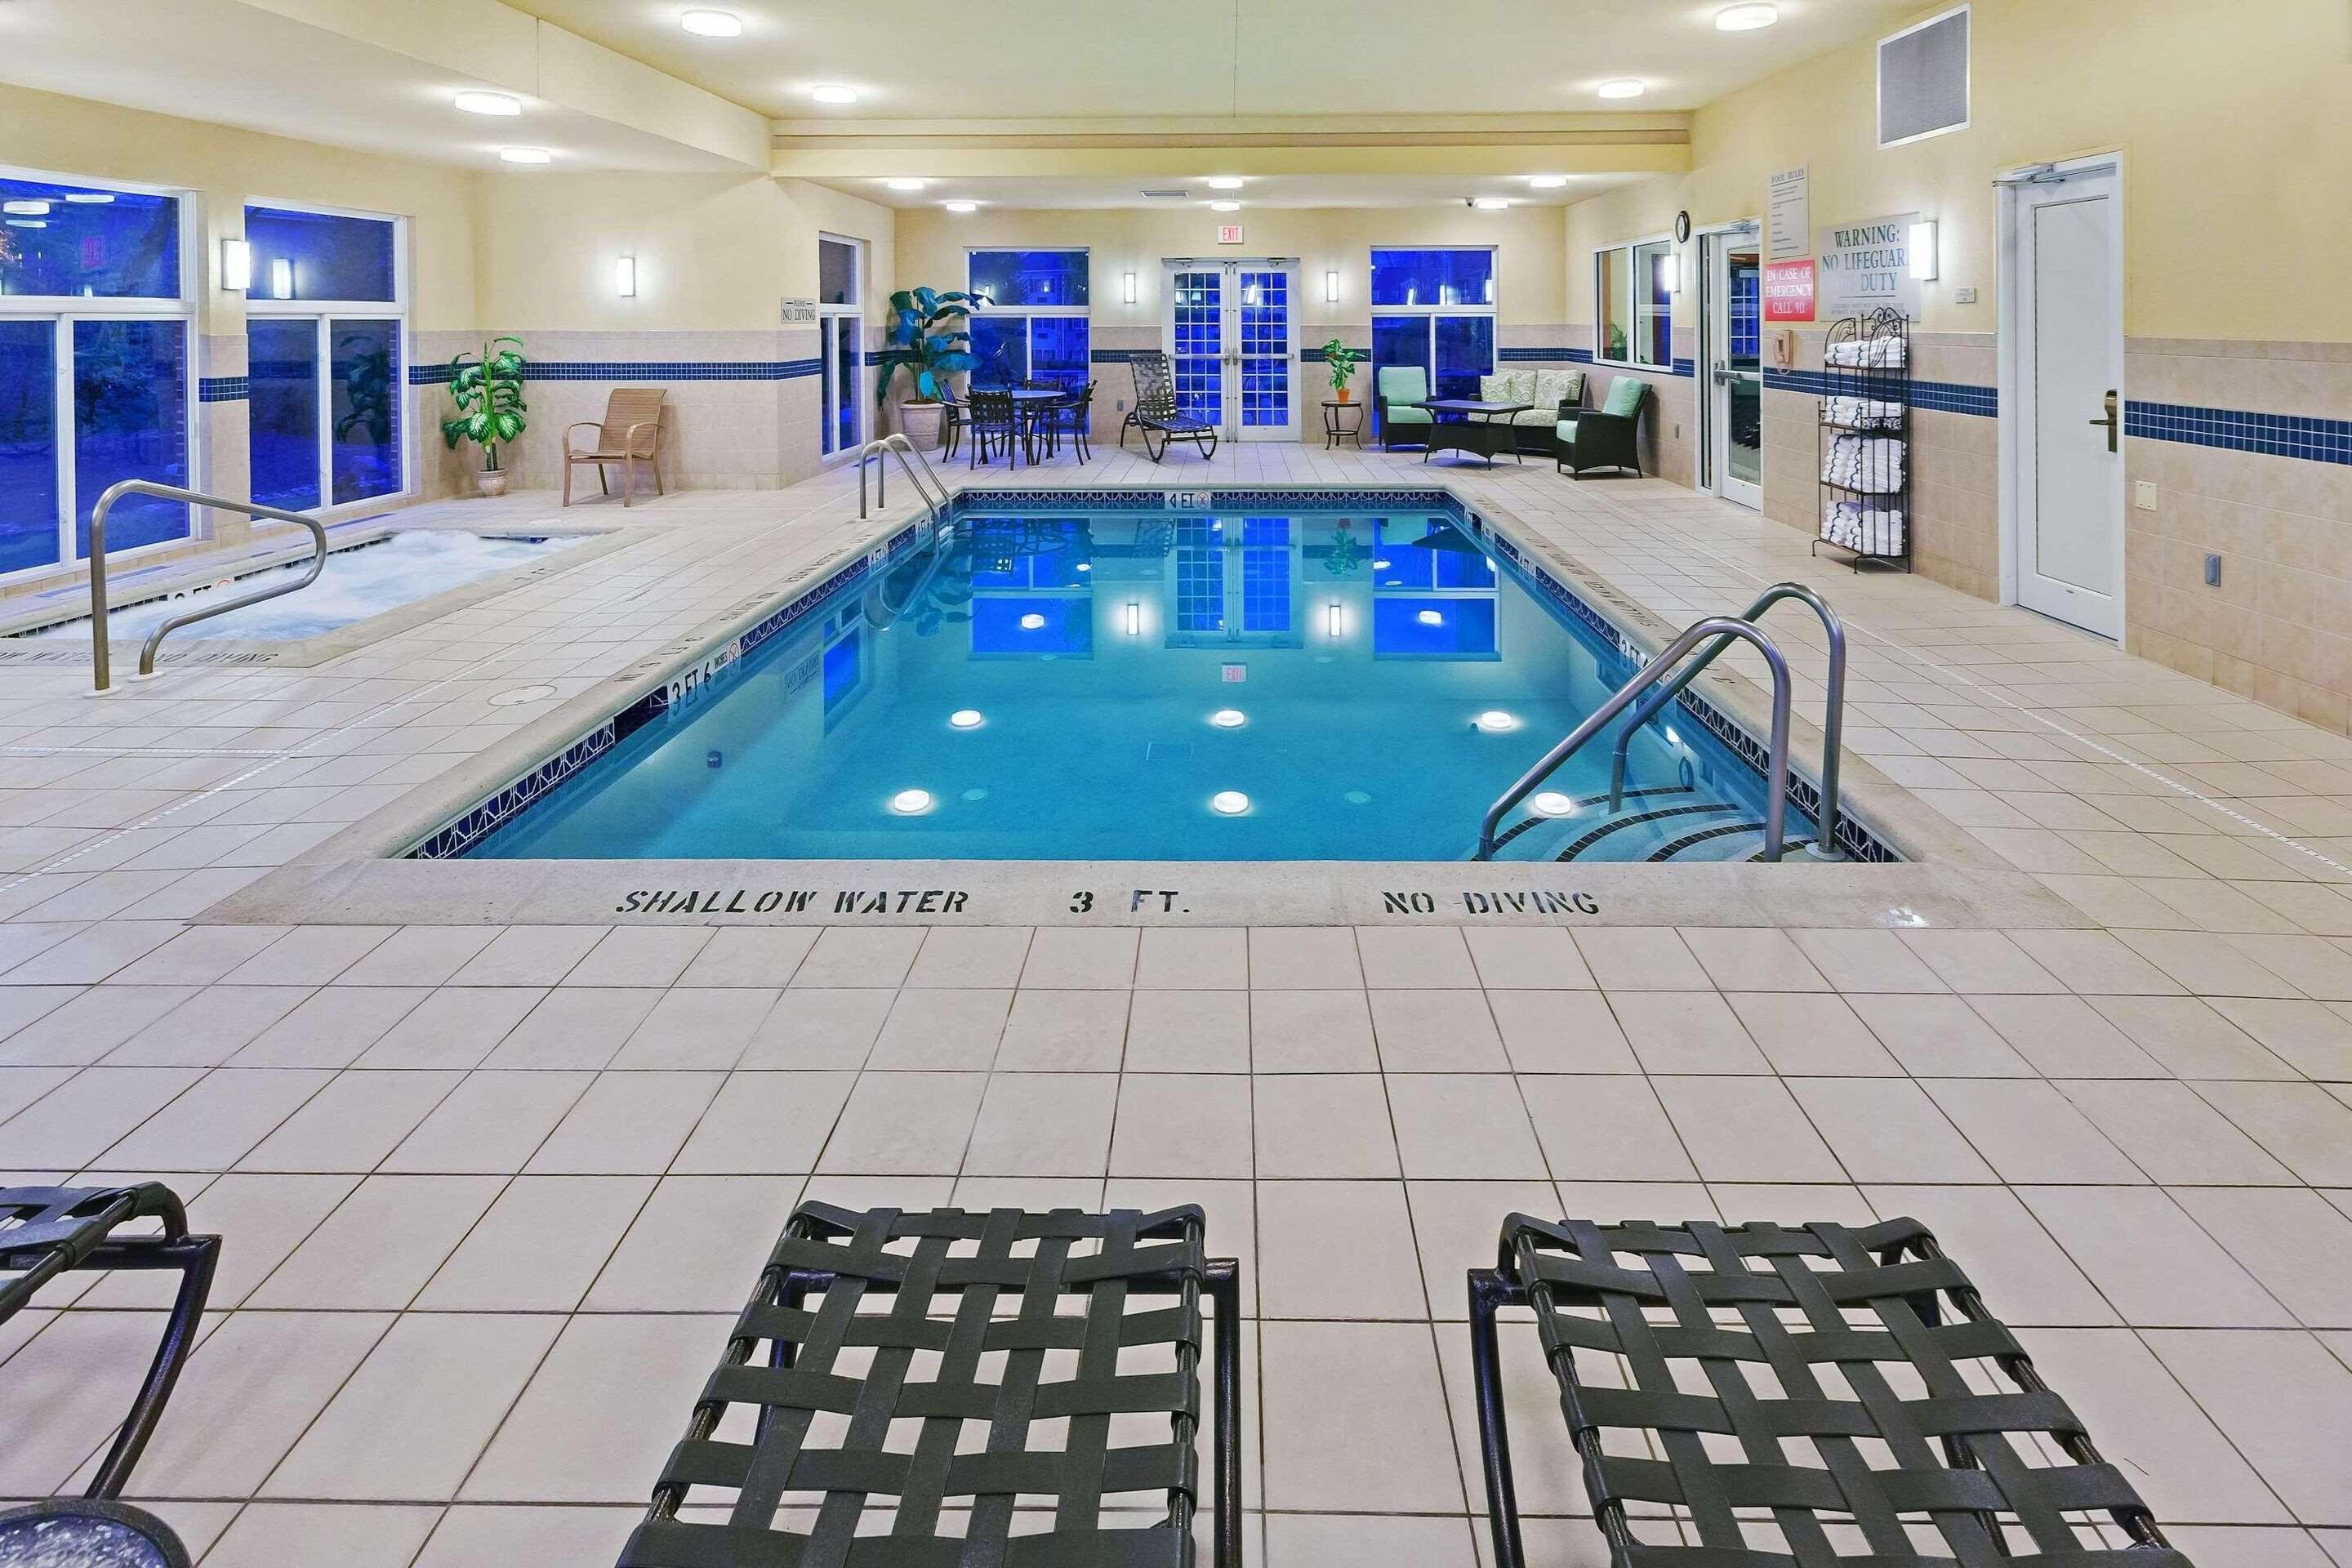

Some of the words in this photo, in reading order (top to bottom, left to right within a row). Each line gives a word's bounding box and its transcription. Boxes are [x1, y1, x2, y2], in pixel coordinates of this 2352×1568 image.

[1223, 227, 1239, 242] EXIT
[1834, 224, 1900, 248] WARNING:
[1822, 254, 1839, 272] NO
[1844, 247, 1909, 270] LIFEGUAR
[1766, 269, 1777, 282] IN
[1779, 267, 1797, 280] CASE
[1801, 265, 1811, 278] OF
[1861, 272, 1898, 292] DUTY
[1766, 283, 1813, 297] EMERGENCY
[782, 309, 792, 321] NO
[795, 309, 816, 321] DIVING
[1772, 301, 1793, 314] CALL
[1796, 301, 1806, 314] 911
[684, 669, 699, 700] FT
[703, 662, 712, 684] 6
[616, 890, 817, 913] SHALLOW
[834, 890, 969, 914] WATER
[1069, 890, 1094, 914] 3
[1130, 889, 1191, 913] FT.
[1380, 890, 1436, 915] NO
[1463, 891, 1600, 915] DIVING
